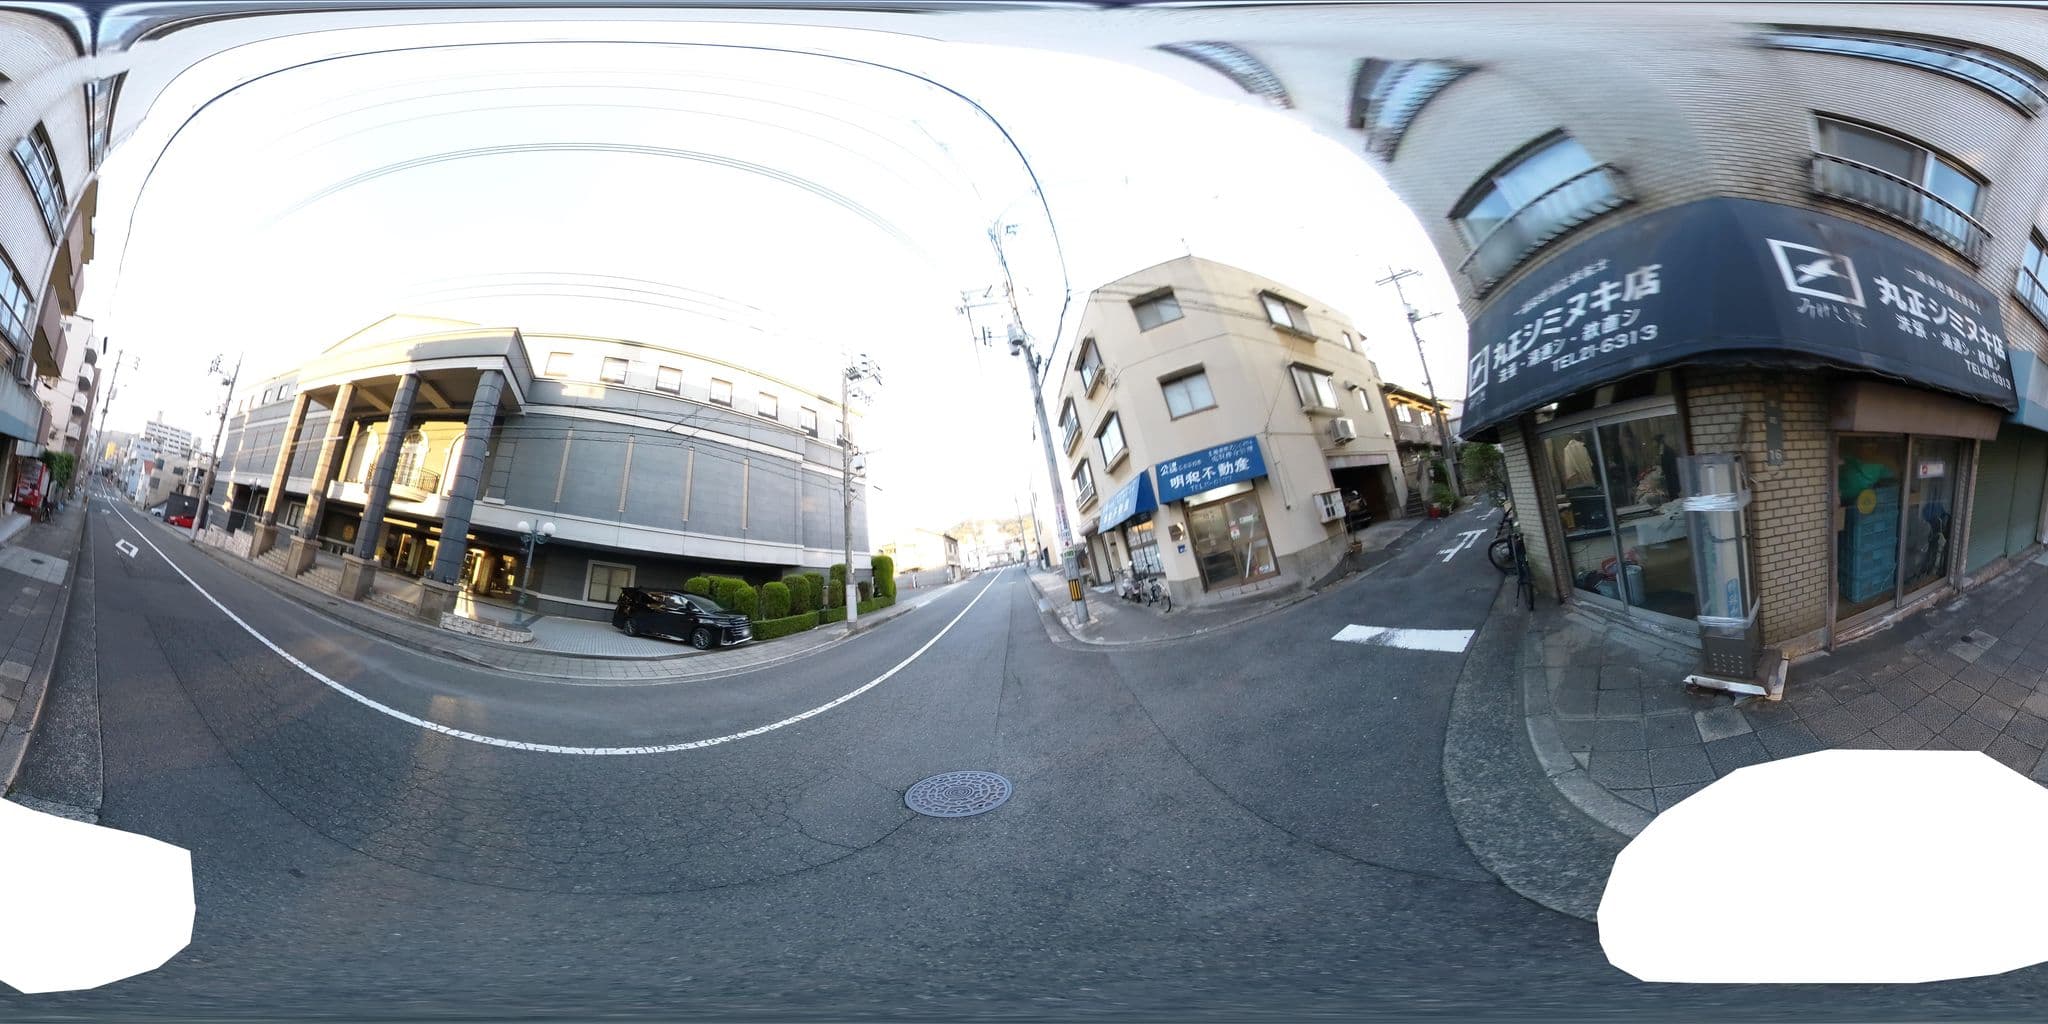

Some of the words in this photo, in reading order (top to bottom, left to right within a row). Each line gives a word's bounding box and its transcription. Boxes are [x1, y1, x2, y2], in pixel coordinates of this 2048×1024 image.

[1491, 264, 1663, 370] 丸正シミヌキ店
[1873, 275, 2006, 362] 丸正シミヌキ店
